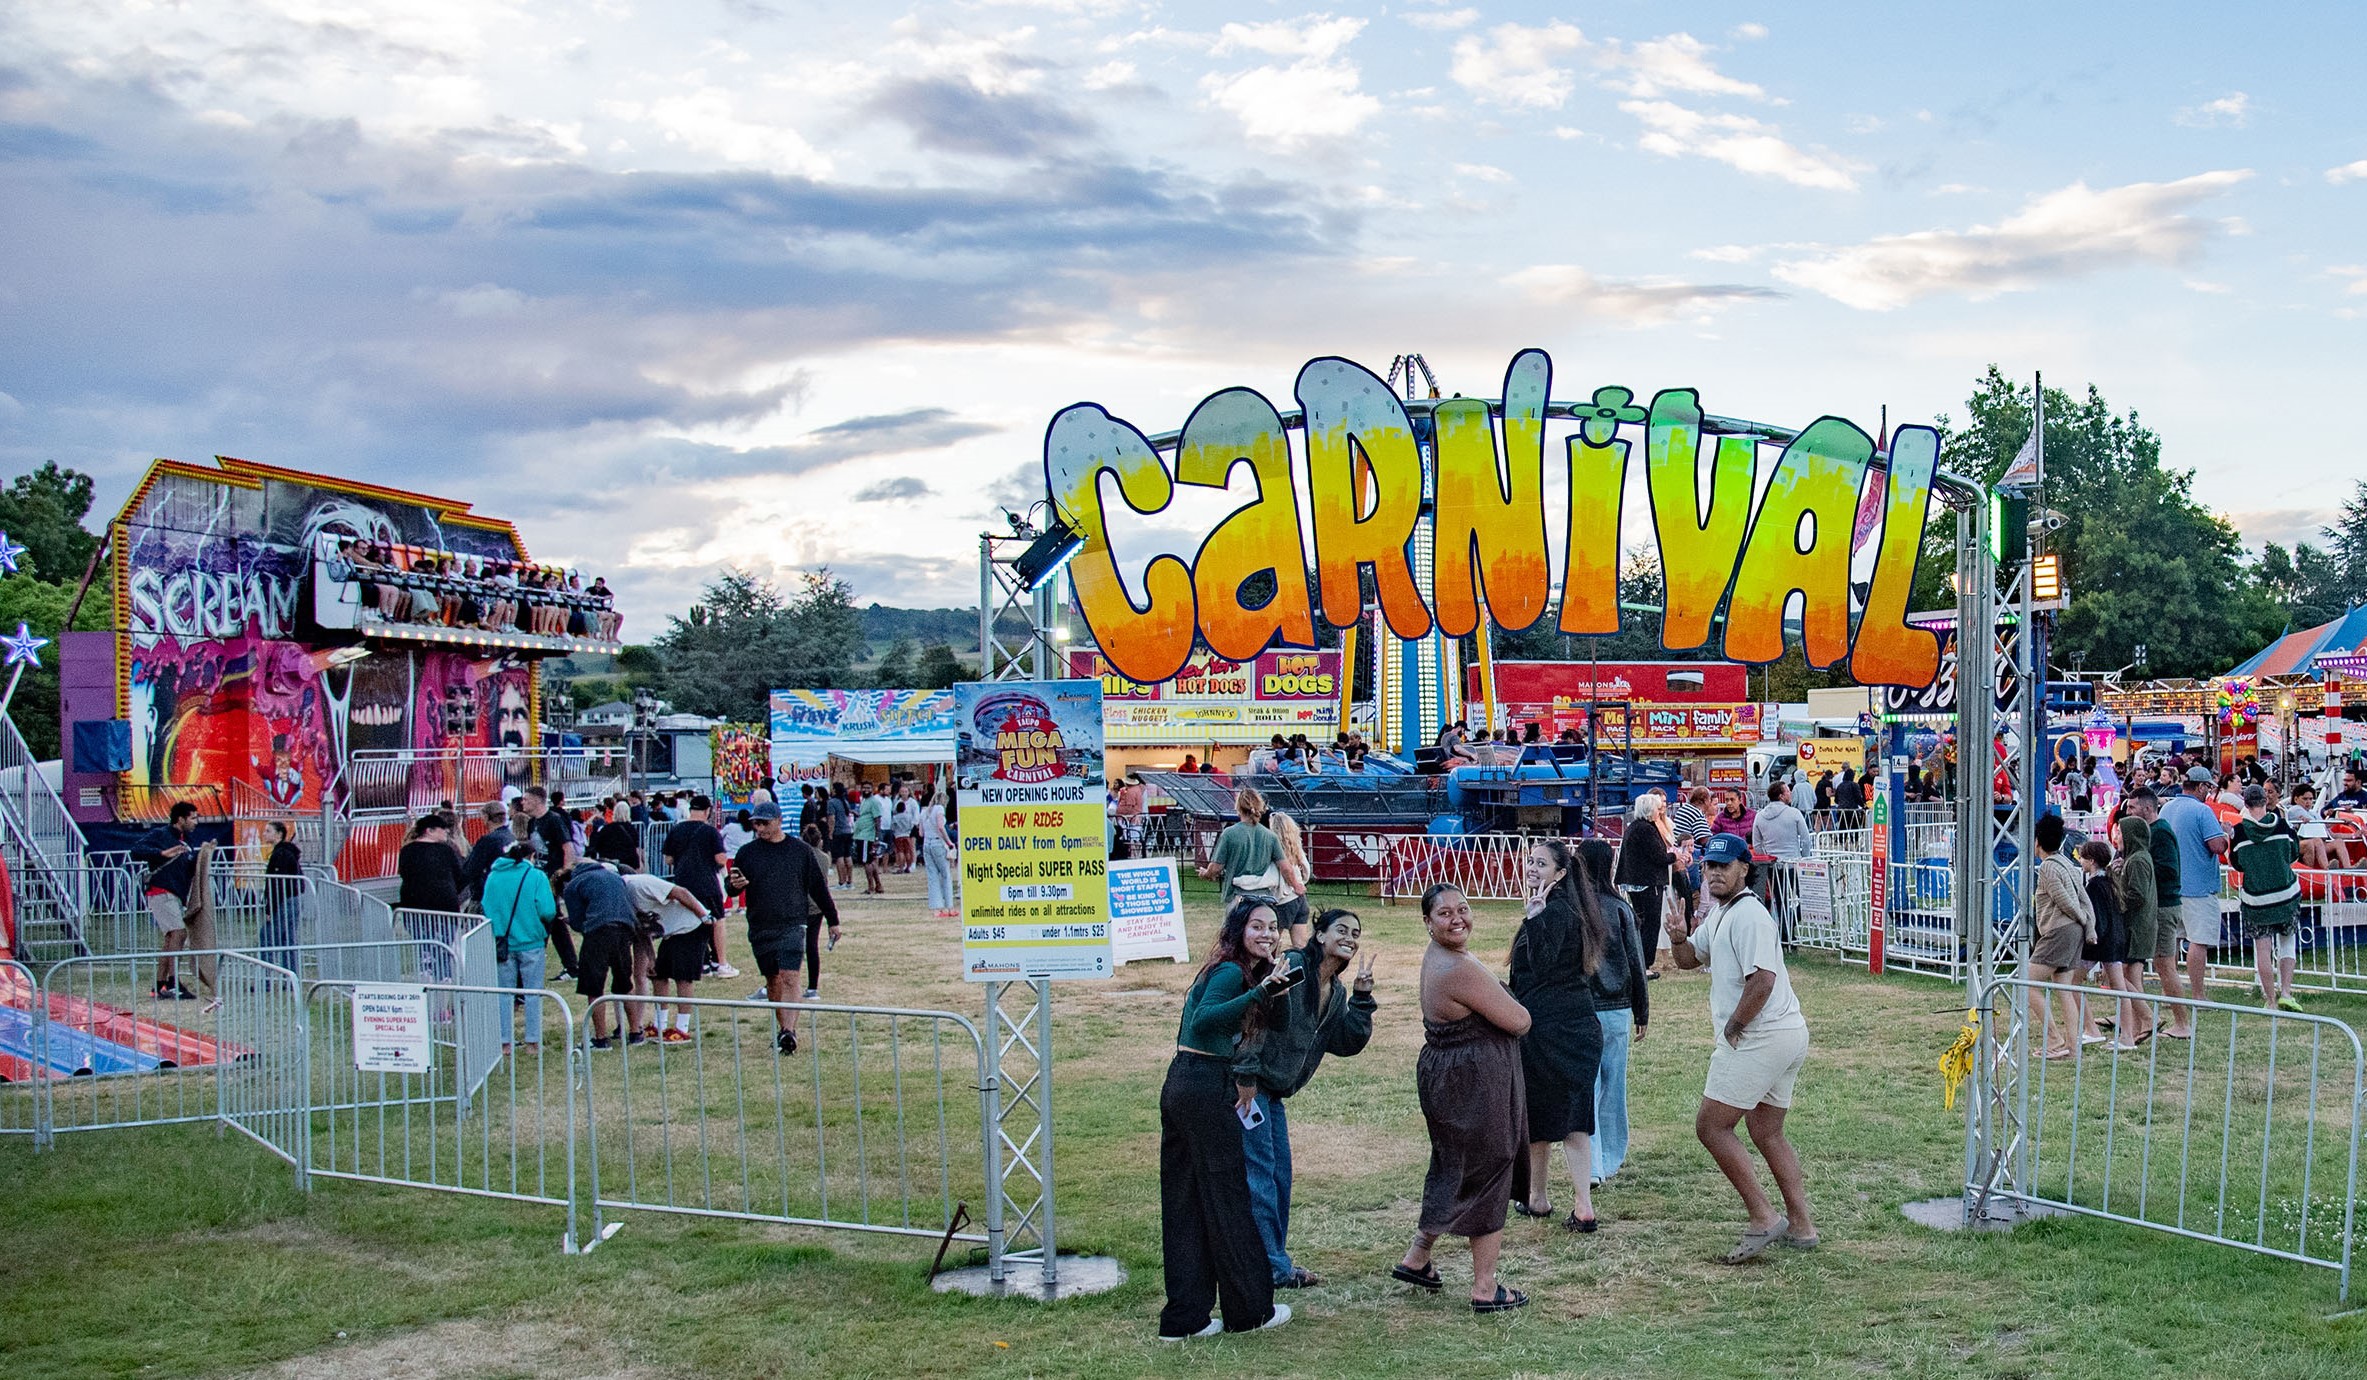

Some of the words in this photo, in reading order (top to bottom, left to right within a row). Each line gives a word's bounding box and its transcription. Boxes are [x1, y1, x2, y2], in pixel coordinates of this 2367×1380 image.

[130, 564, 302, 652] SCREAM
[1277, 655, 1319, 676] HOT
[1176, 678, 1207, 694] HOT
[1208, 678, 1247, 694] DOGS
[1263, 674, 1333, 695] DOGS
[1016, 718, 1040, 727] TAUPO
[1603, 711, 1641, 725] Mai
[1692, 709, 1733, 725] family
[842, 721, 876, 731] KRUSH
[996, 730, 1065, 750] MEGA
[2221, 732, 2257, 744] Exlorer
[1802, 744, 1814, 755] $6
[1001, 748, 1058, 772] FUN
[1006, 766, 1055, 782] CARNIVAL
[982, 788, 1003, 803] NEW
[1005, 787, 1048, 803] OPENING
[1051, 786, 1084, 801] HOURS
[1003, 812, 1027, 829] NEW
[1033, 810, 1064, 828] RIDES
[964, 836, 992, 851] OPEN
[998, 836, 1027, 850] DAILY
[1032, 835, 1055, 849] from
[1061, 835, 1082, 852] 6pm
[967, 862, 993, 883] Night
[996, 861, 1033, 881] Special
[1039, 861, 1073, 877] SUPER
[1079, 860, 1105, 876] PASS
[1132, 869, 1160, 878] WHOLE
[1007, 886, 1024, 900] 6pm
[1027, 885, 1037, 897] till
[1041, 885, 1067, 900] 9.30pm
[1110, 885, 1136, 893] SHORT
[1136, 882, 1170, 891] STAFFED
[1125, 899, 1151, 907] THOSE
[971, 906, 1005, 918] unlimited
[1008, 905, 1026, 917] rides
[1030, 907, 1039, 916] on
[1043, 904, 1052, 916] all
[1056, 903, 1096, 916] attractions
[1120, 906, 1154, 915] SHOWED
[1126, 917, 1146, 926] STAY
[1146, 915, 1163, 923] SAFE
[968, 927, 989, 940] Adults
[992, 927, 1006, 939] $45
[1042, 926, 1061, 938] under
[1064, 925, 1089, 938] 1.1mtrs
[1092, 925, 1105, 937] $25
[1127, 929, 1162, 938] CARNIVAL
[1134, 923, 1157, 932] ENJOY
[362, 1005, 375, 1013] OPEN
[376, 1005, 391, 1013] DAILY
[374, 1024, 395, 1032] SPECIAL
